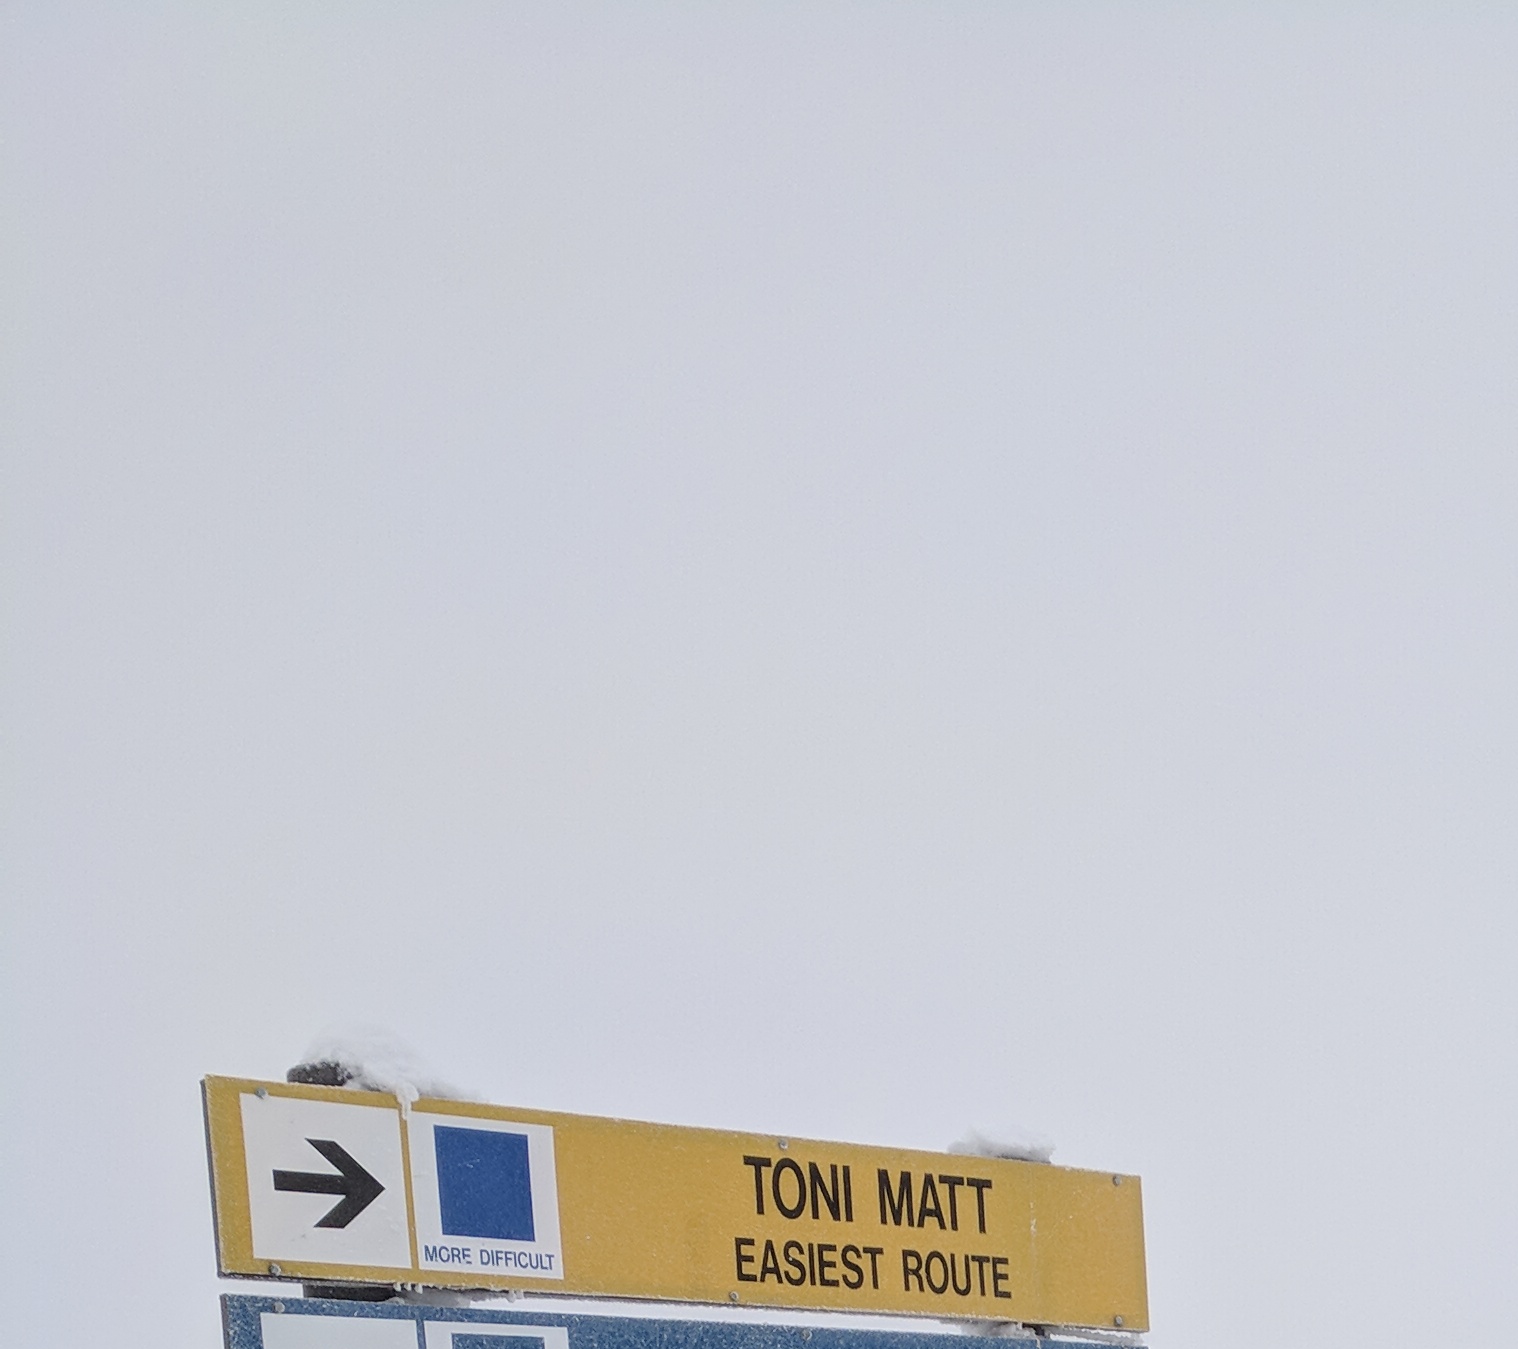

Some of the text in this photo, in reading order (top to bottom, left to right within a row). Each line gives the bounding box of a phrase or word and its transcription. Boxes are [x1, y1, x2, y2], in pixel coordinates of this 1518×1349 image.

[742, 1155, 992, 1234] TONI MATT
[424, 1245, 555, 1271] MORE DIFFICULT
[734, 1237, 1012, 1299] EASIEST ROUTE
